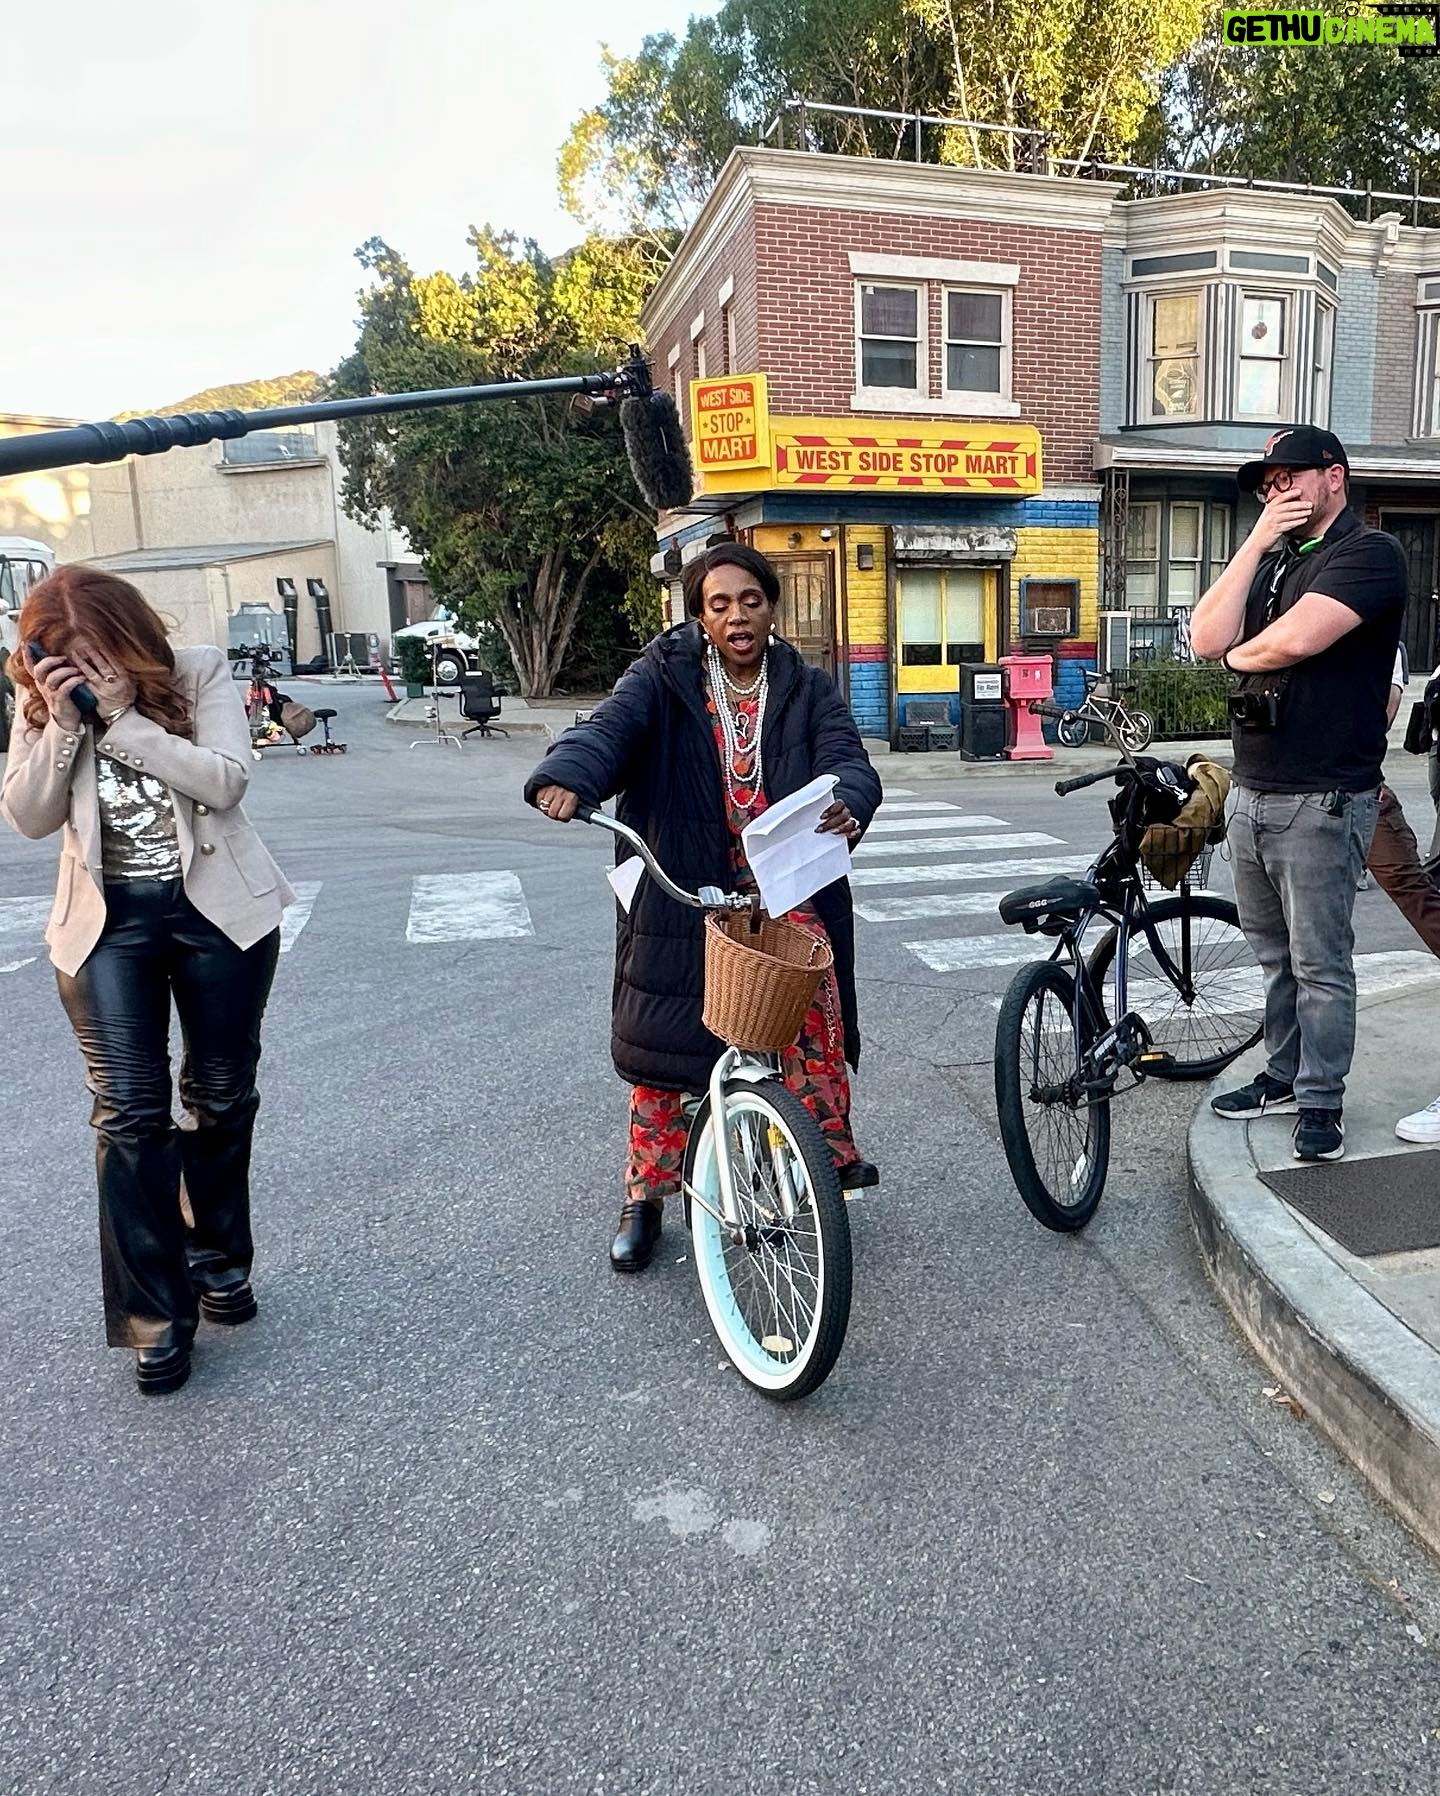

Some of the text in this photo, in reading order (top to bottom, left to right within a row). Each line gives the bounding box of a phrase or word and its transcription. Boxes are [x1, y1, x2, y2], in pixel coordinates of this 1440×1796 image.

[700, 387, 752, 408] WEST SIDE
[710, 412, 744, 434] STOP
[703, 436, 754, 460] MART
[795, 449, 1019, 475] WEST SIDE STOP MART
